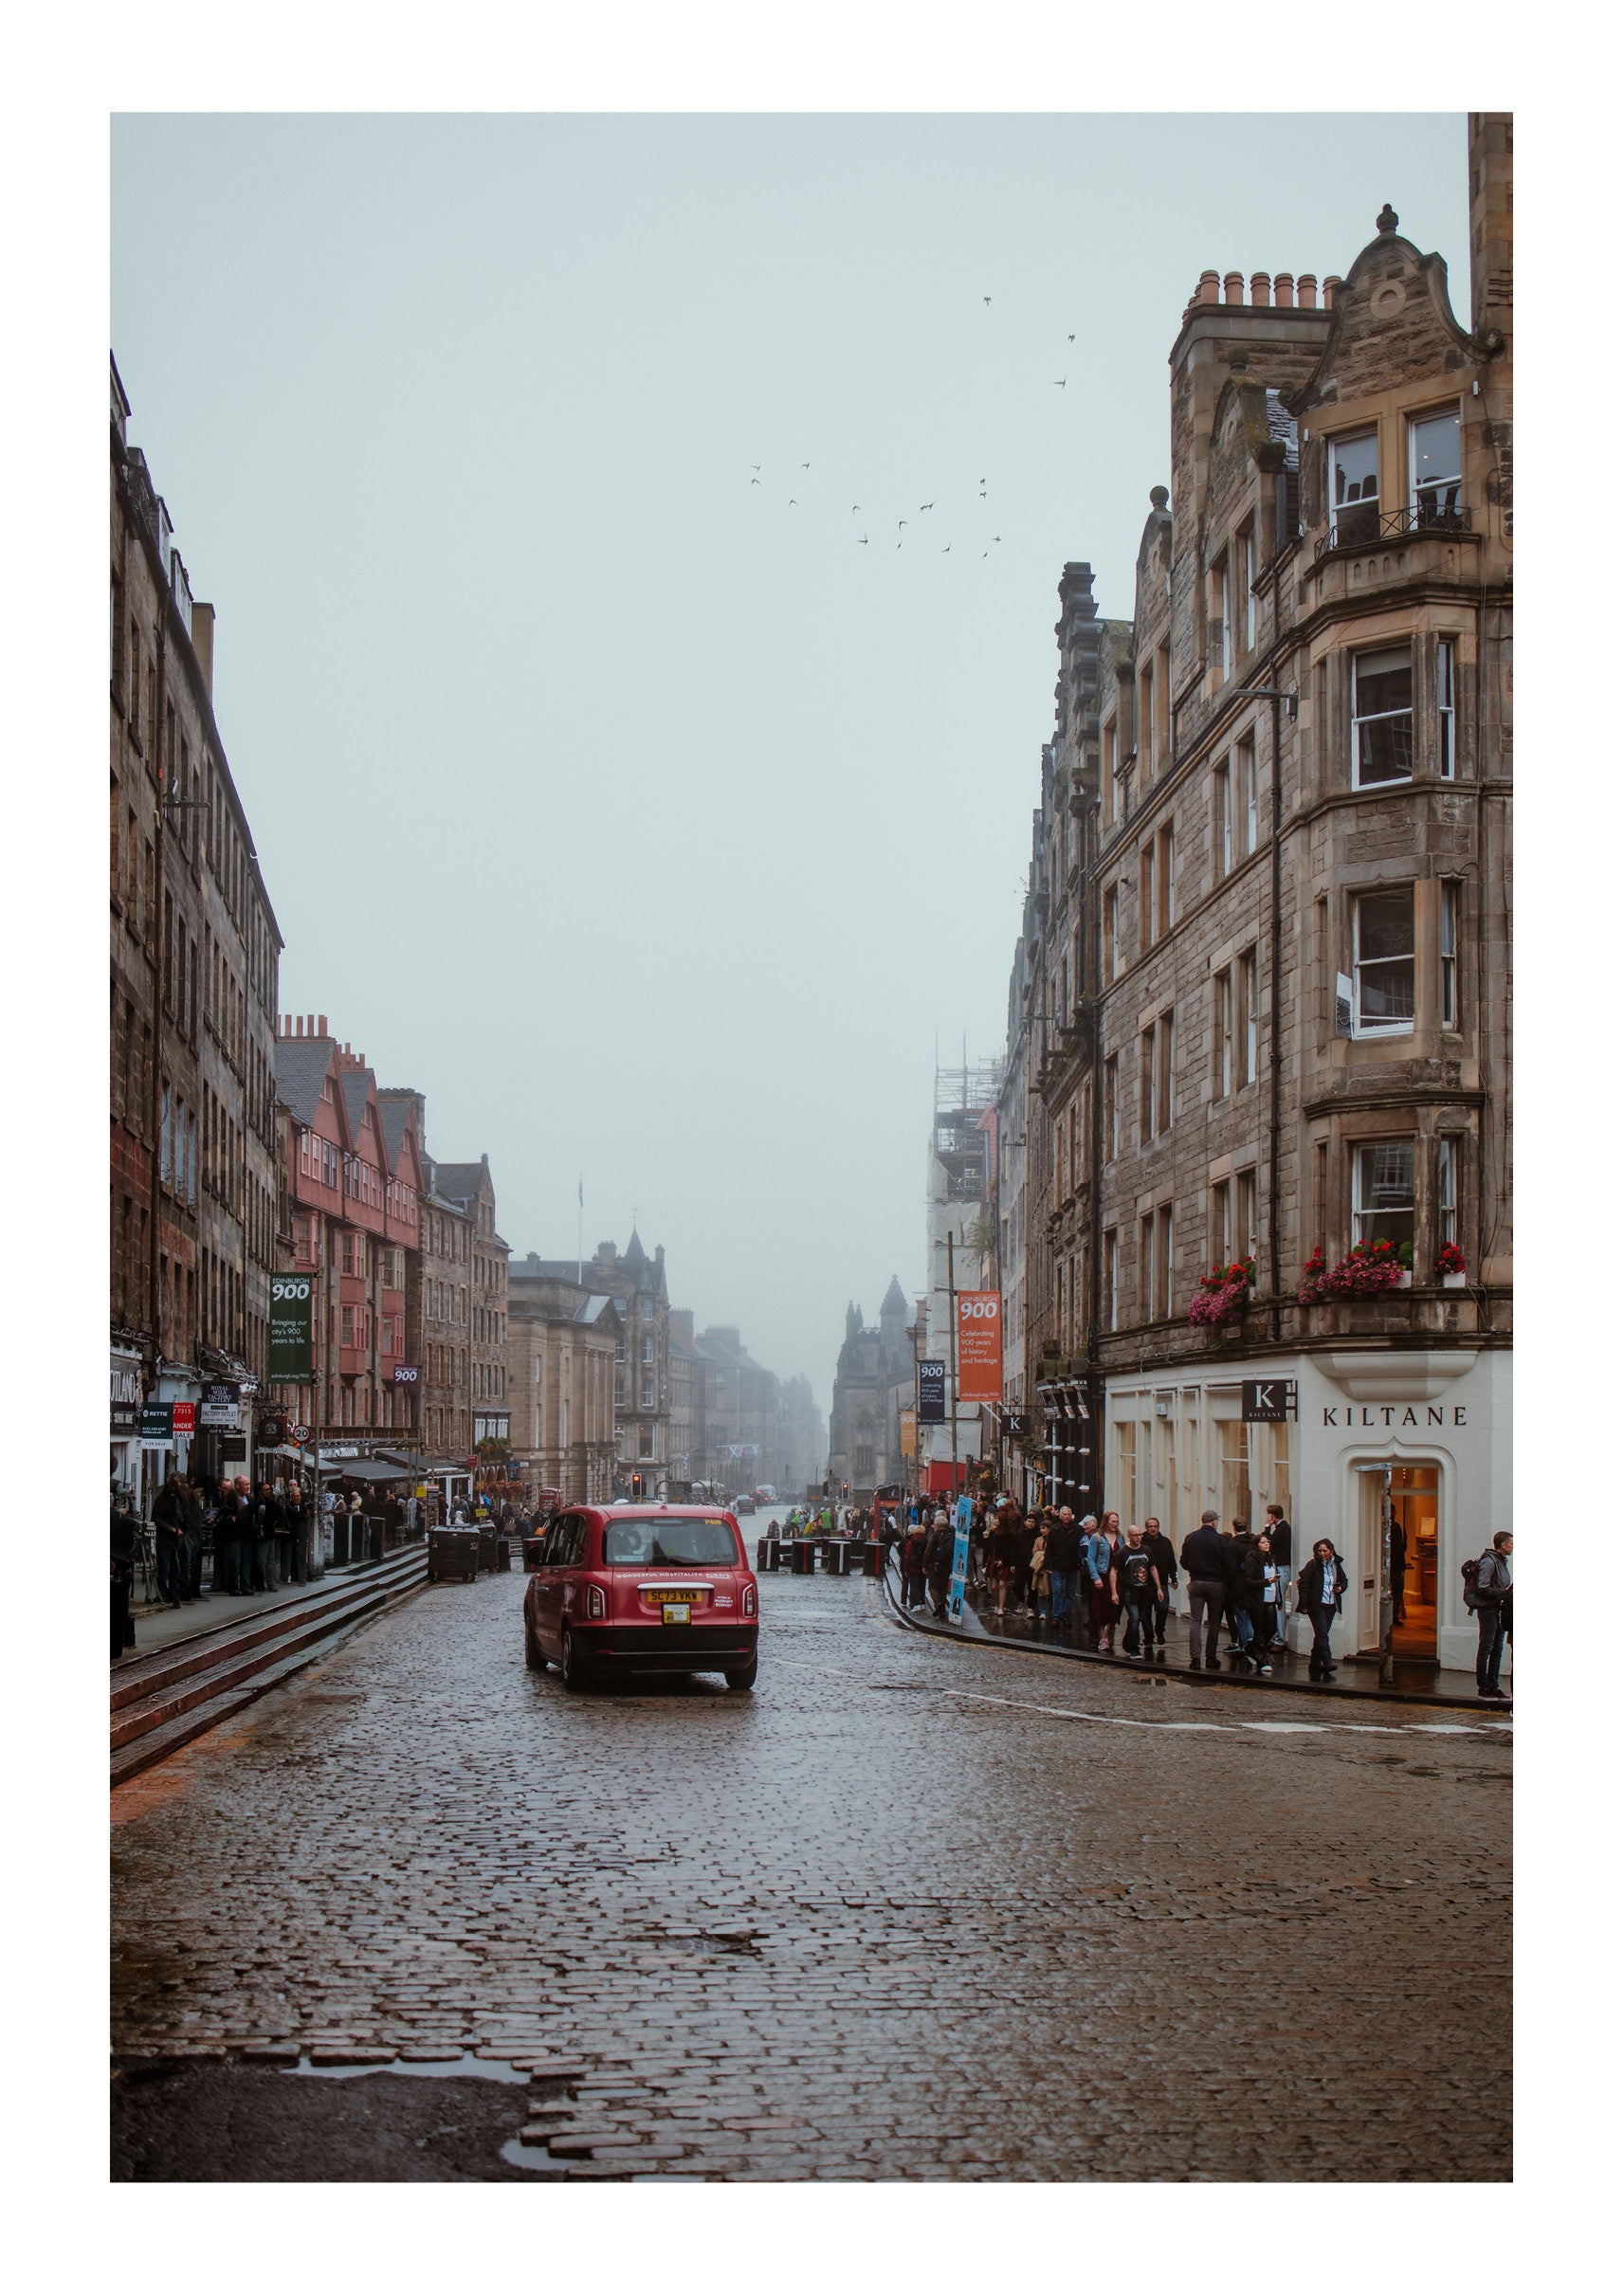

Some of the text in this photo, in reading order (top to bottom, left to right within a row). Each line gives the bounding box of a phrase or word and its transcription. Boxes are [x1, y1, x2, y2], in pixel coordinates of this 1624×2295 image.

[272, 1284, 310, 1302] 900
[960, 1302, 997, 1321] 900
[271, 1319, 296, 1327] Bringing
[960, 1330, 994, 1339] Celebrating
[974, 1357, 998, 1365] heritage
[394, 1371, 417, 1382] 900
[921, 1366, 943, 1377] 900
[1255, 1385, 1274, 1408] K
[1323, 1407, 1468, 1427] KILTANE
[1010, 1417, 1020, 1430] K
[651, 1591, 698, 1601] SC73 VKW
